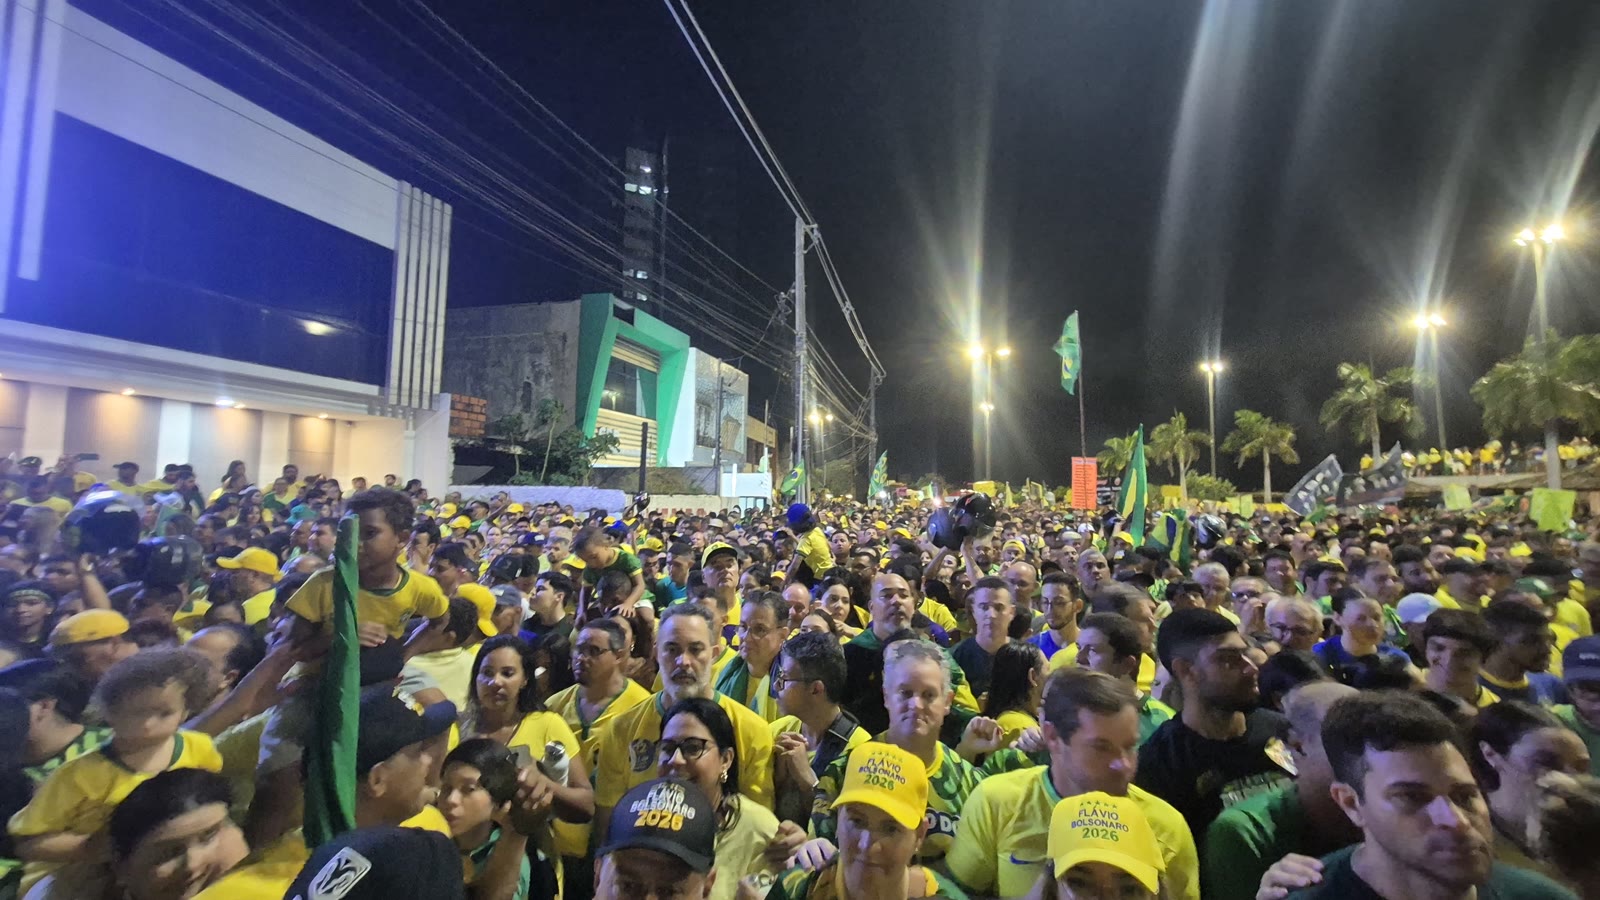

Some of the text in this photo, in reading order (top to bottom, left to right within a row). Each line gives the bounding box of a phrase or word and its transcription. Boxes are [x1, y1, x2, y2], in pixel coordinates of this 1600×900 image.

[867, 757, 902, 773] FLÁVIO
[858, 766, 906, 785] BOLSONARO
[864, 774, 894, 790] 2026
[630, 800, 696, 820] BOLSONARO
[1078, 804, 1119, 820] FLÁVIO
[633, 810, 684, 831] 2026
[1071, 819, 1129, 833] BOLSONARO
[1082, 827, 1119, 842] 2026
